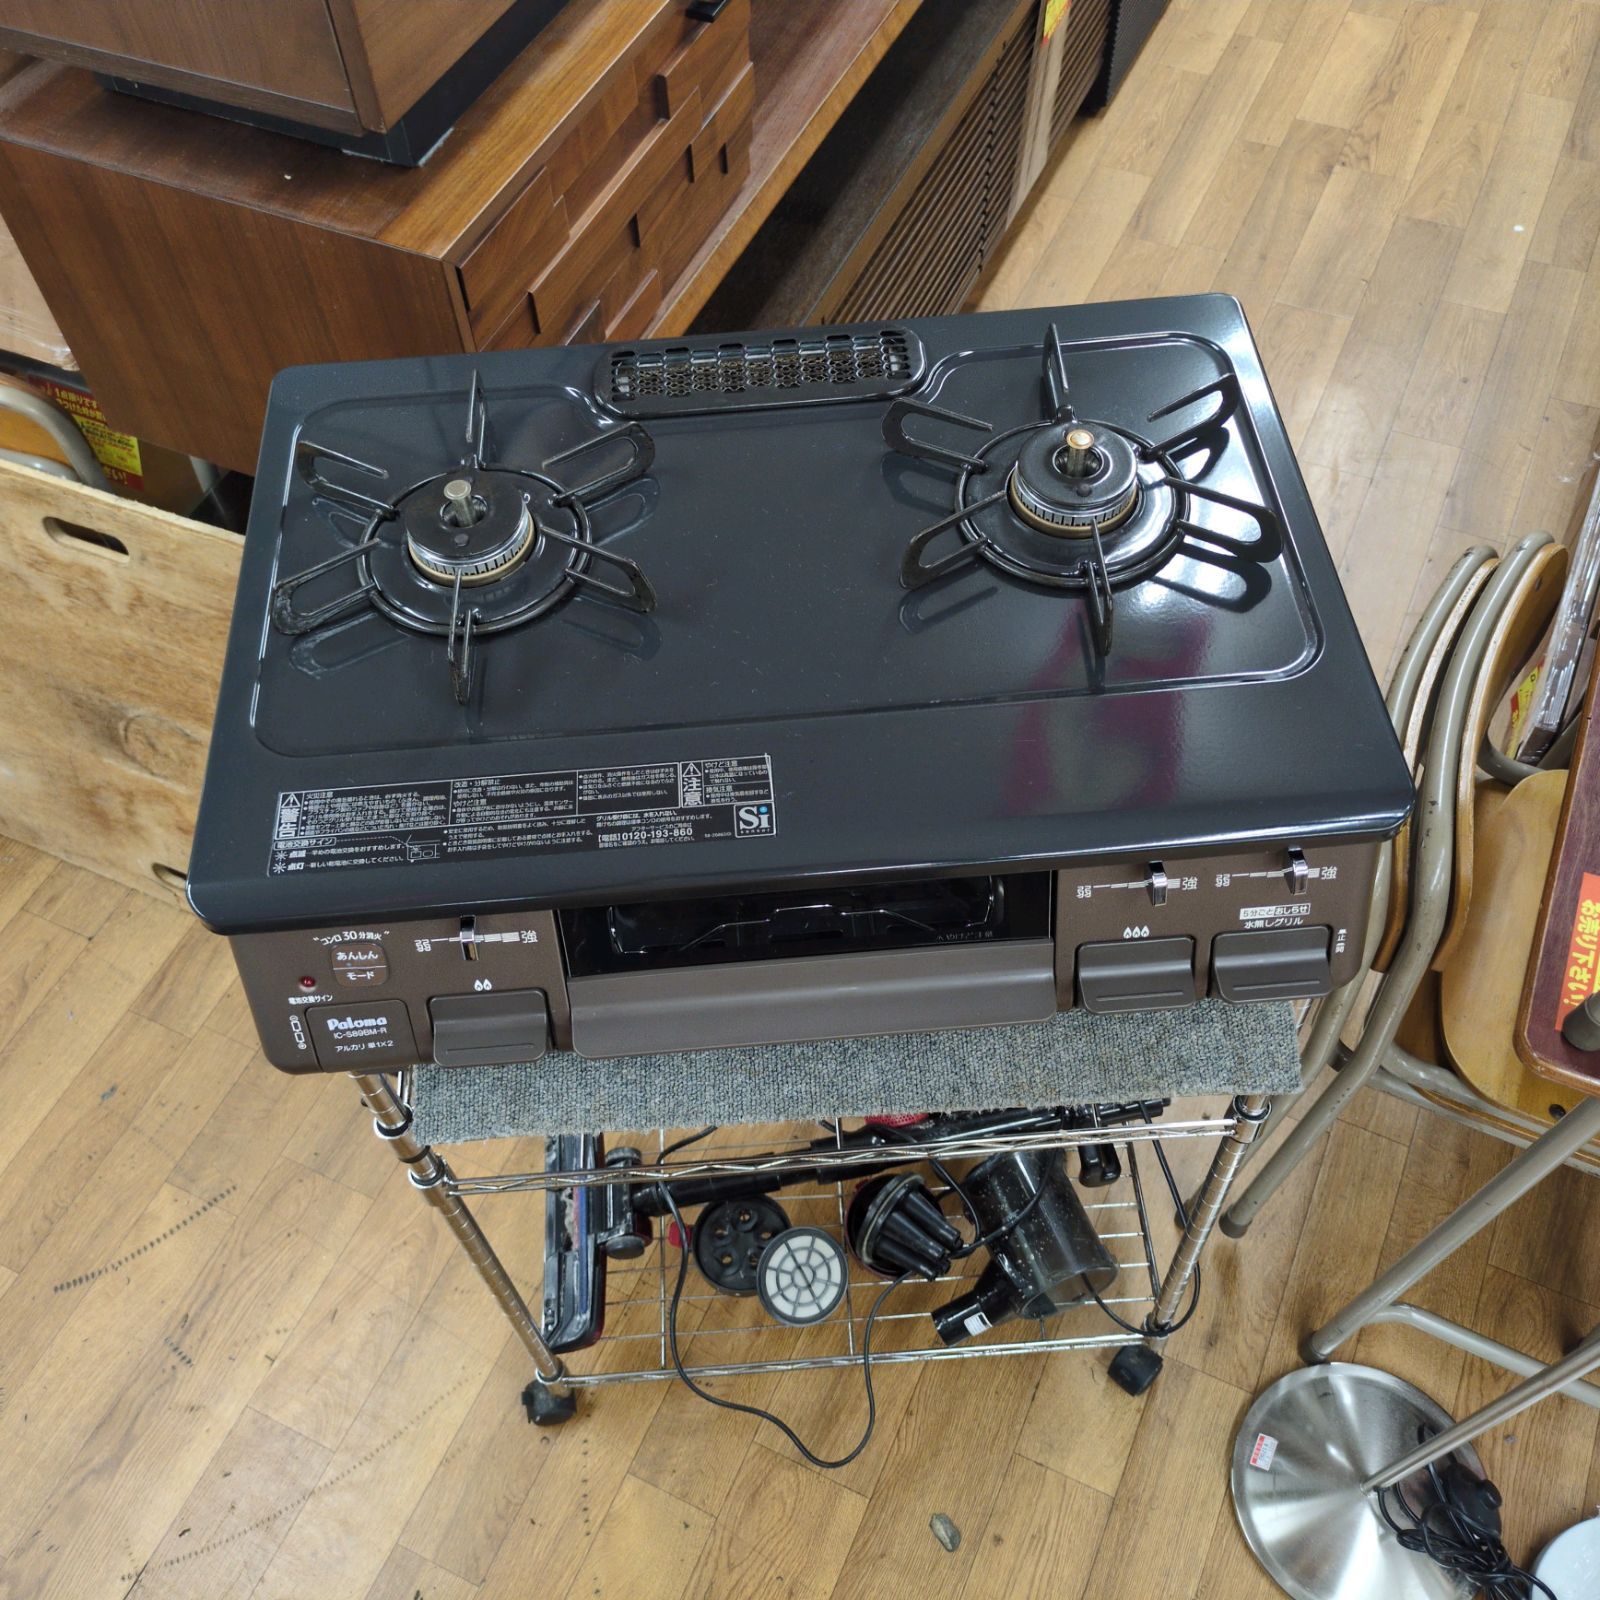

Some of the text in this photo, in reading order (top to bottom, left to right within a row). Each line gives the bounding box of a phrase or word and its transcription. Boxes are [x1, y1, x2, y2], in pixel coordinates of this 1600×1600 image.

[683, 777, 703, 806] 注意
[279, 808, 300, 838] 警告
[739, 806, 770, 831] Si
[621, 828, 693, 842] 0120-193-860
[1214, 865, 1338, 888] 弱 強
[1076, 876, 1198, 899] 弱 強
[1244, 917, 1305, 930] 水無しグリル
[414, 929, 539, 952] 弱 強
[336, 950, 379, 961] あんしん
[346, 971, 376, 981] モード
[326, 1016, 388, 1031] Paloma
[334, 1043, 366, 1053] アルカリ
